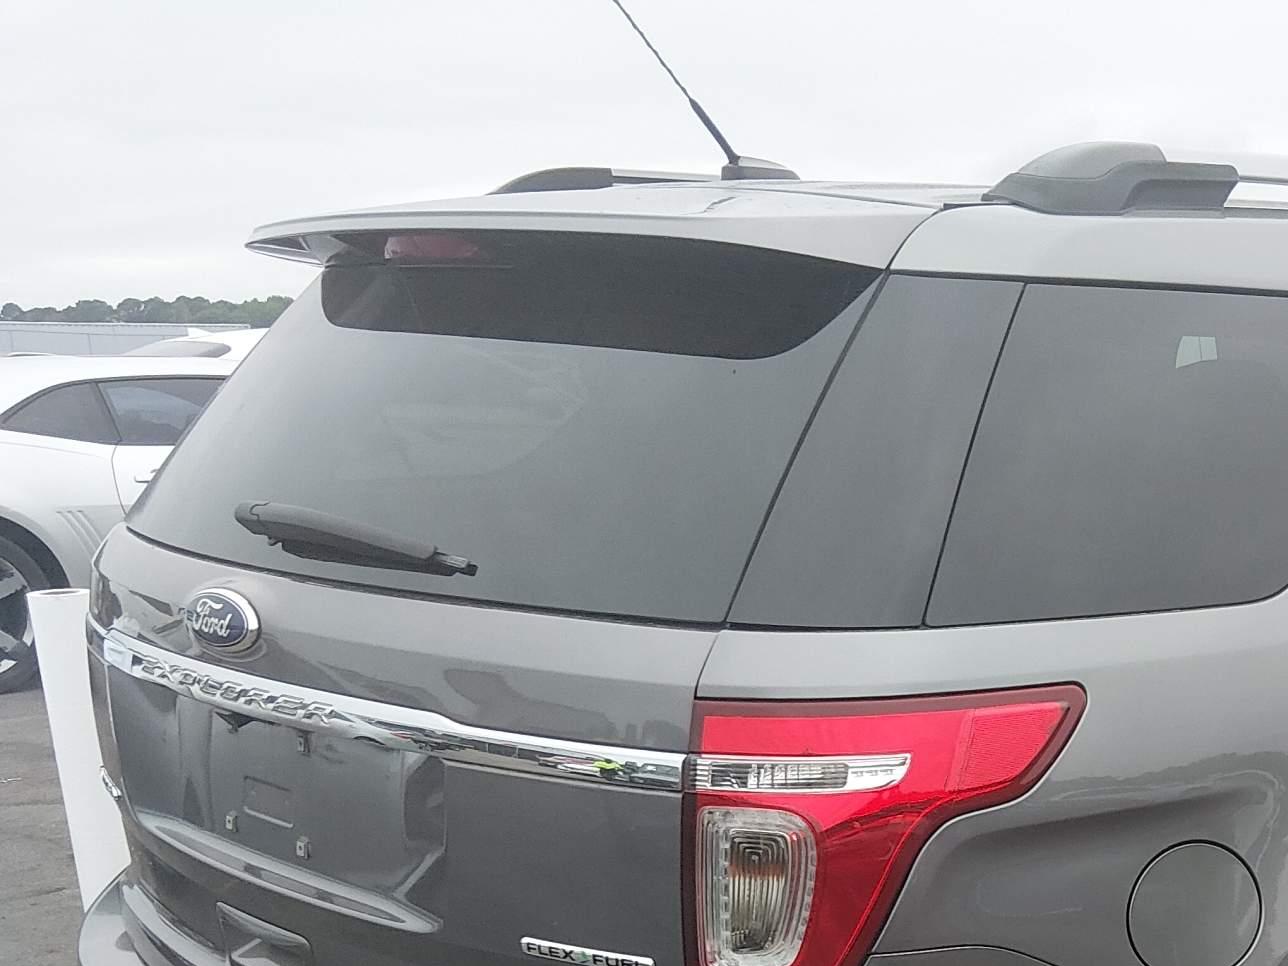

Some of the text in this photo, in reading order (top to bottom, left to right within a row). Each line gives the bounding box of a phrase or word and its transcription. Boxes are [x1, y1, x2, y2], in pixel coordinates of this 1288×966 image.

[192, 598, 233, 638] Ford
[141, 655, 335, 724] EXPLORER
[526, 942, 576, 961] FLEX
